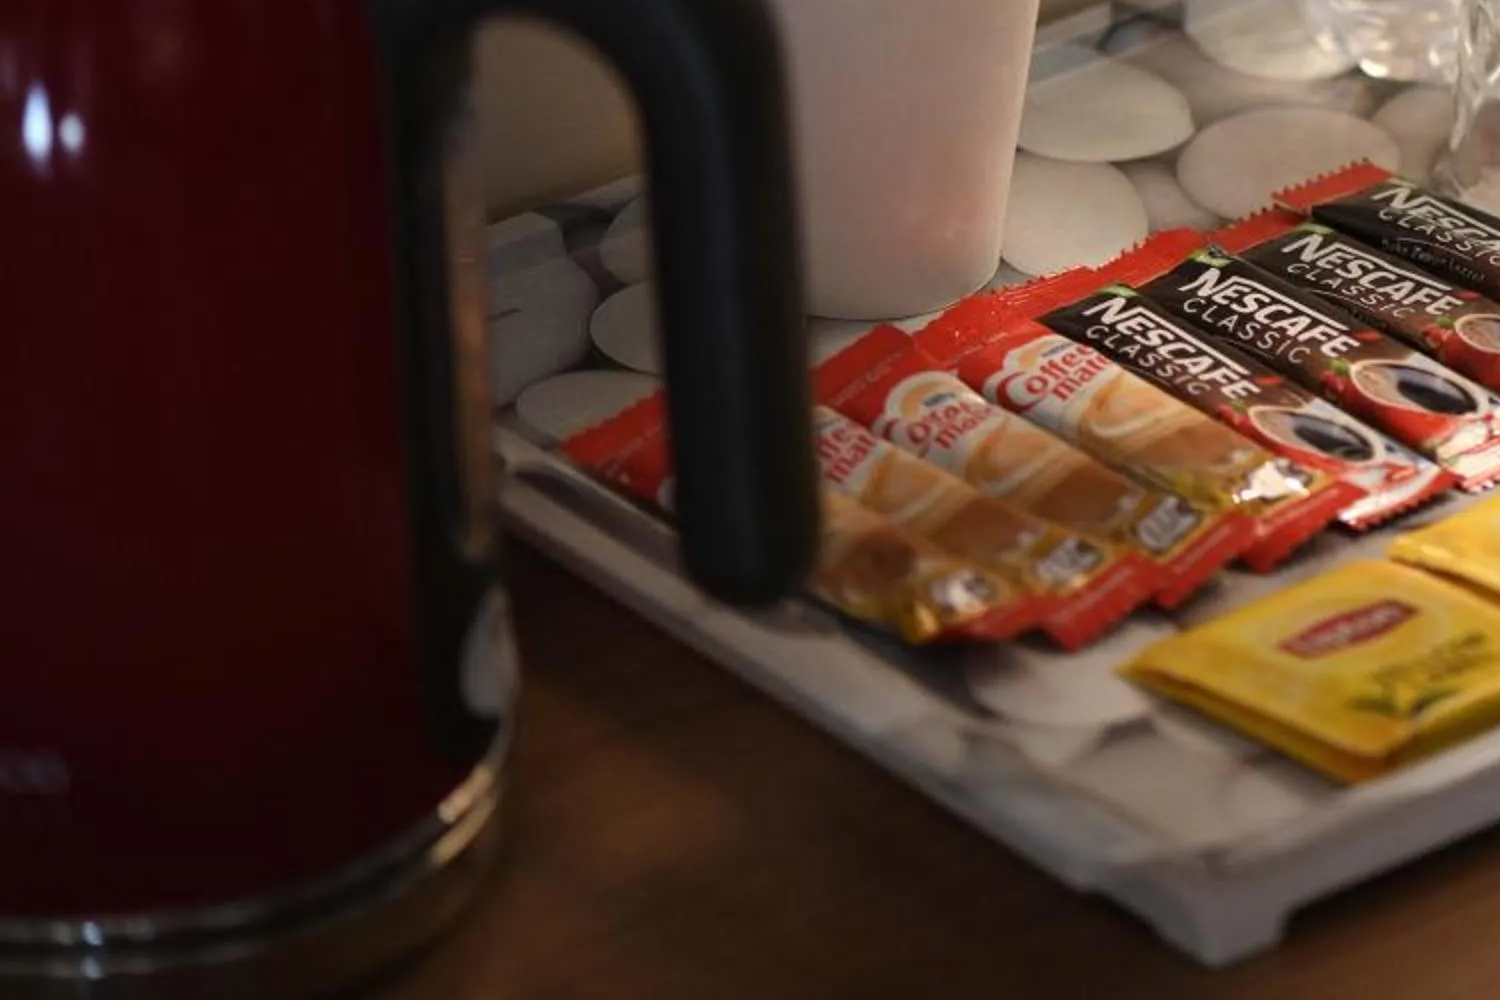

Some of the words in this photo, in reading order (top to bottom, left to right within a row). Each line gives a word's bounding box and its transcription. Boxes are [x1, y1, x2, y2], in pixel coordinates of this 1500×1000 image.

[1286, 262, 1417, 320] CLASSIC
[1085, 325, 1212, 396] CLASSIC
[1182, 297, 1313, 366] CLASSIC
